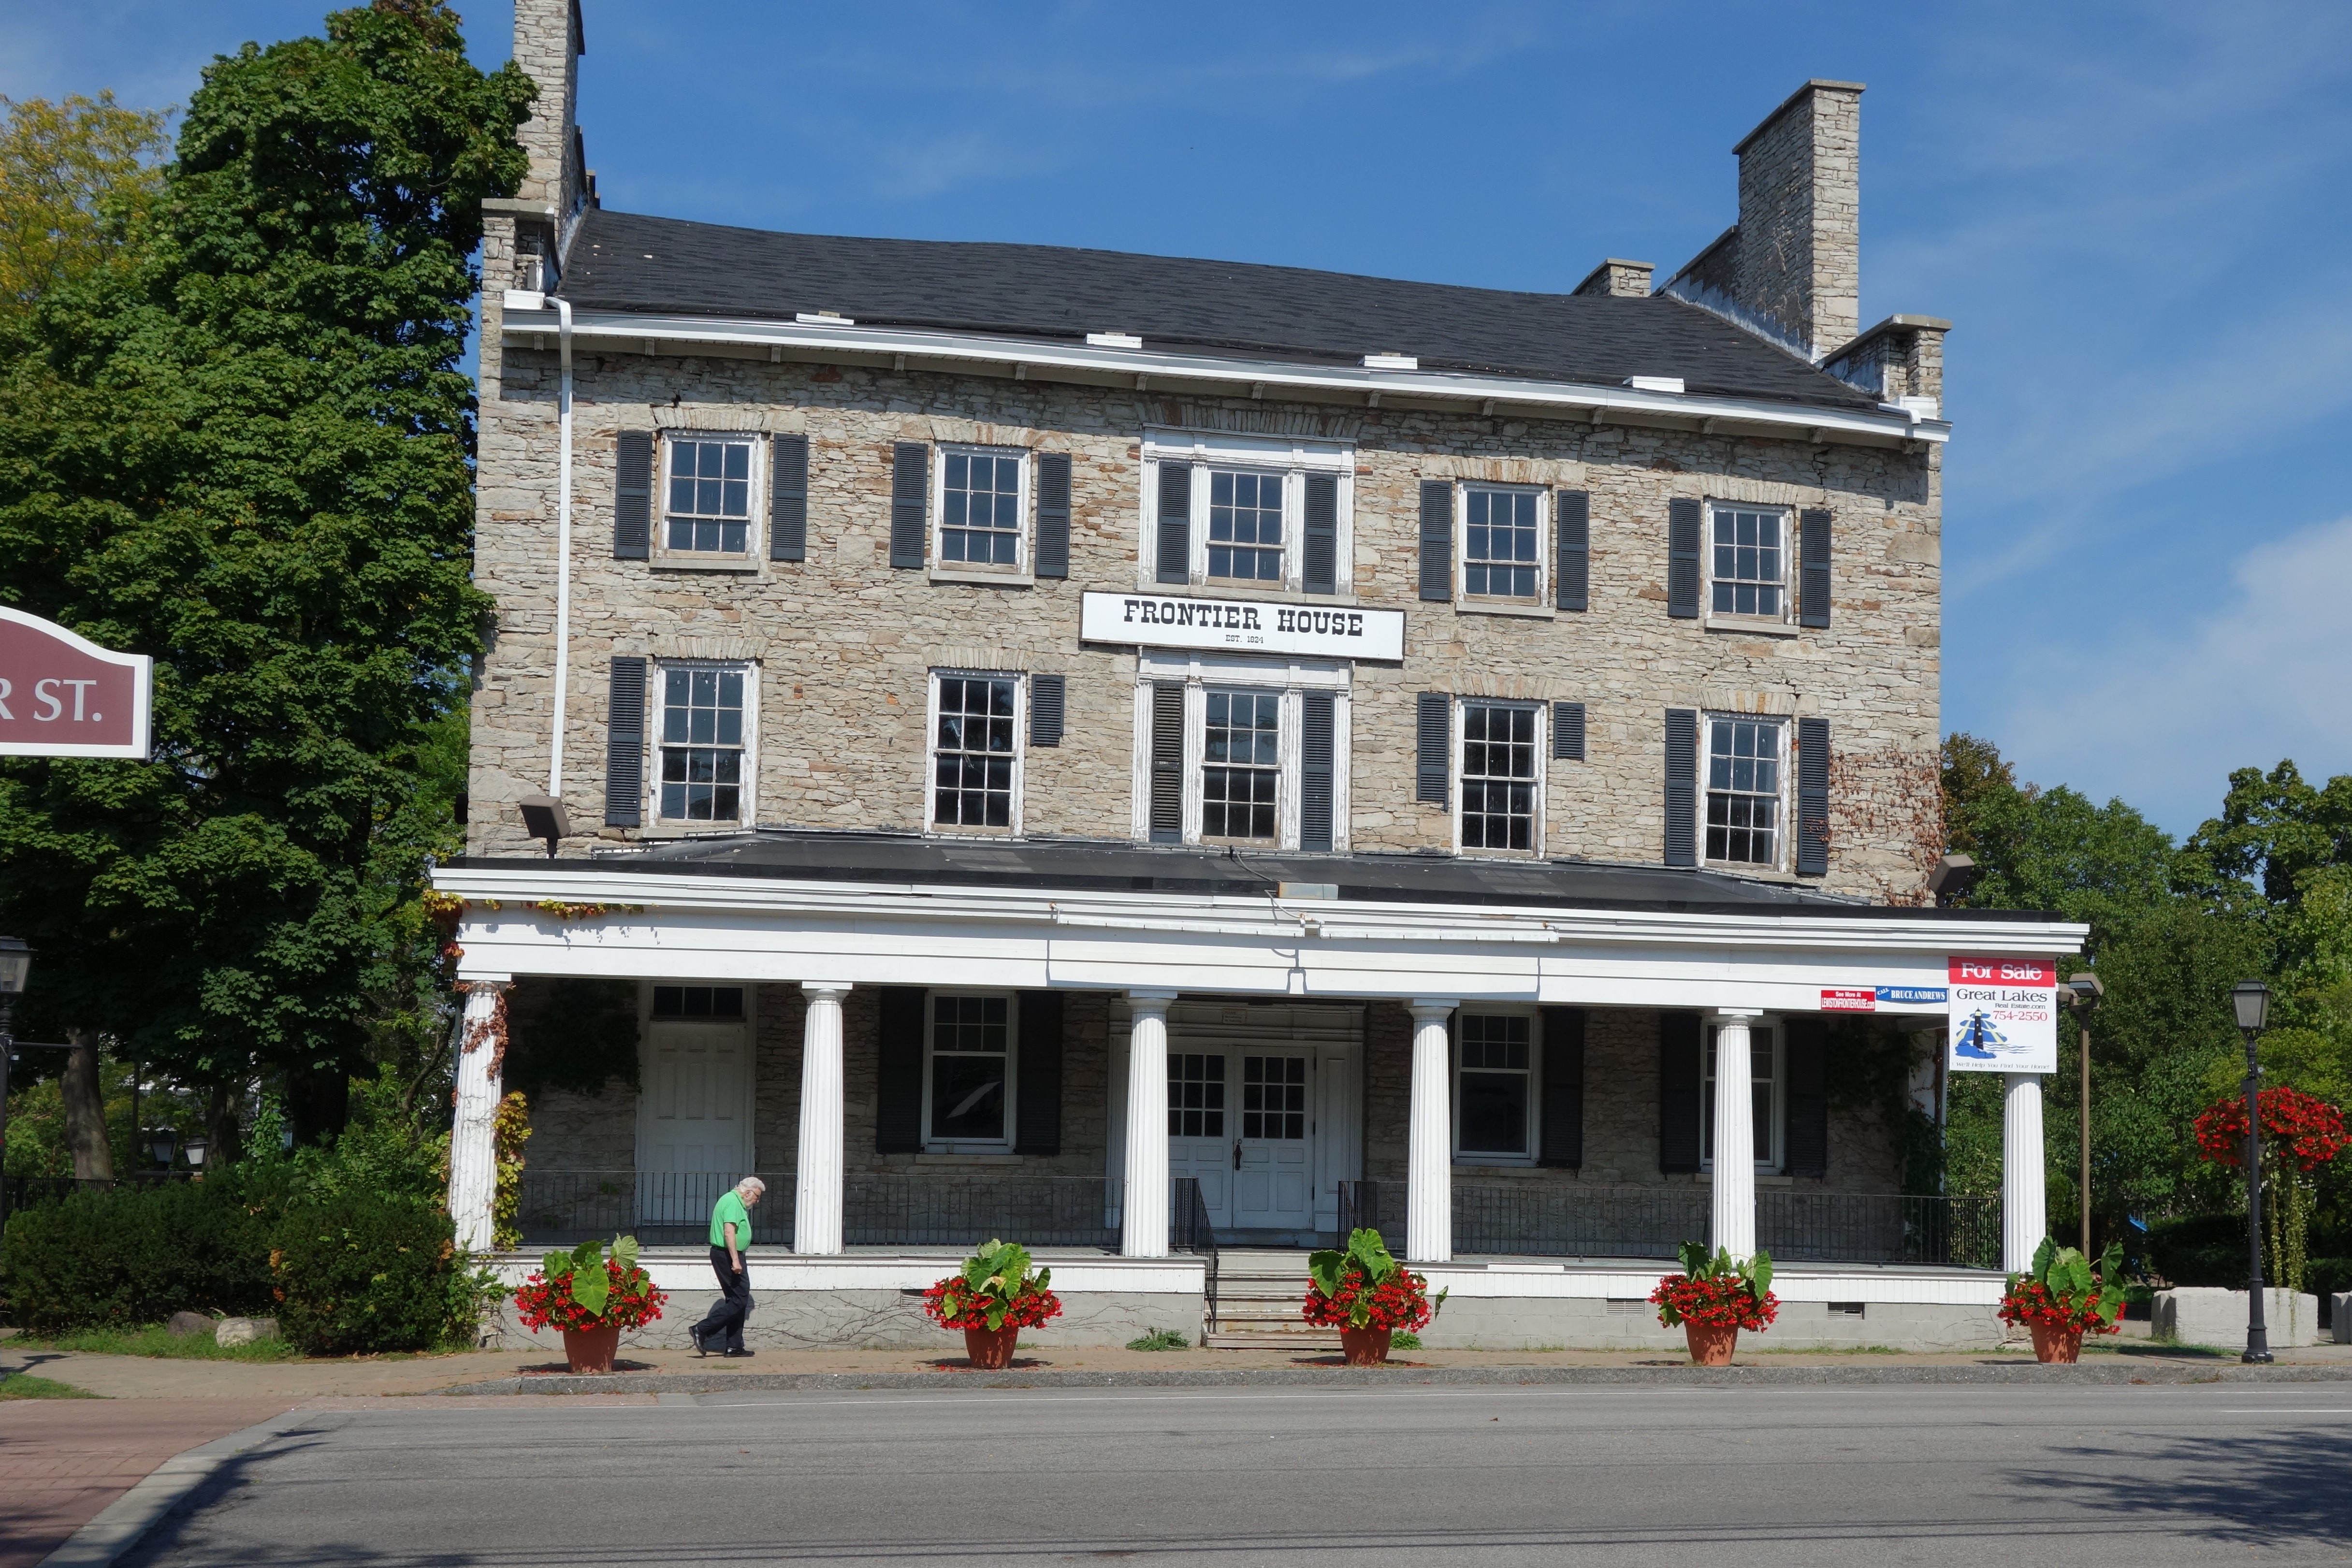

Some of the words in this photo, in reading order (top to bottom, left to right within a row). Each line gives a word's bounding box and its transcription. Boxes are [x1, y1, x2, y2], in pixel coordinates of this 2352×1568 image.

[1124, 599, 1261, 630] FRONTIER
[1278, 609, 1363, 636] HOUSE
[1247, 636, 1263, 644] 1824
[33, 679, 102, 721] ST.
[1961, 962, 1993, 978] For
[2001, 963, 2042, 980] Sale
[1891, 990, 1913, 999] BRUCE
[1914, 991, 1945, 1000] ANDREWS
[1957, 988, 1996, 1001] Great
[2002, 990, 2047, 1002] Lakes
[1993, 1011, 2047, 1021] 754-2550
